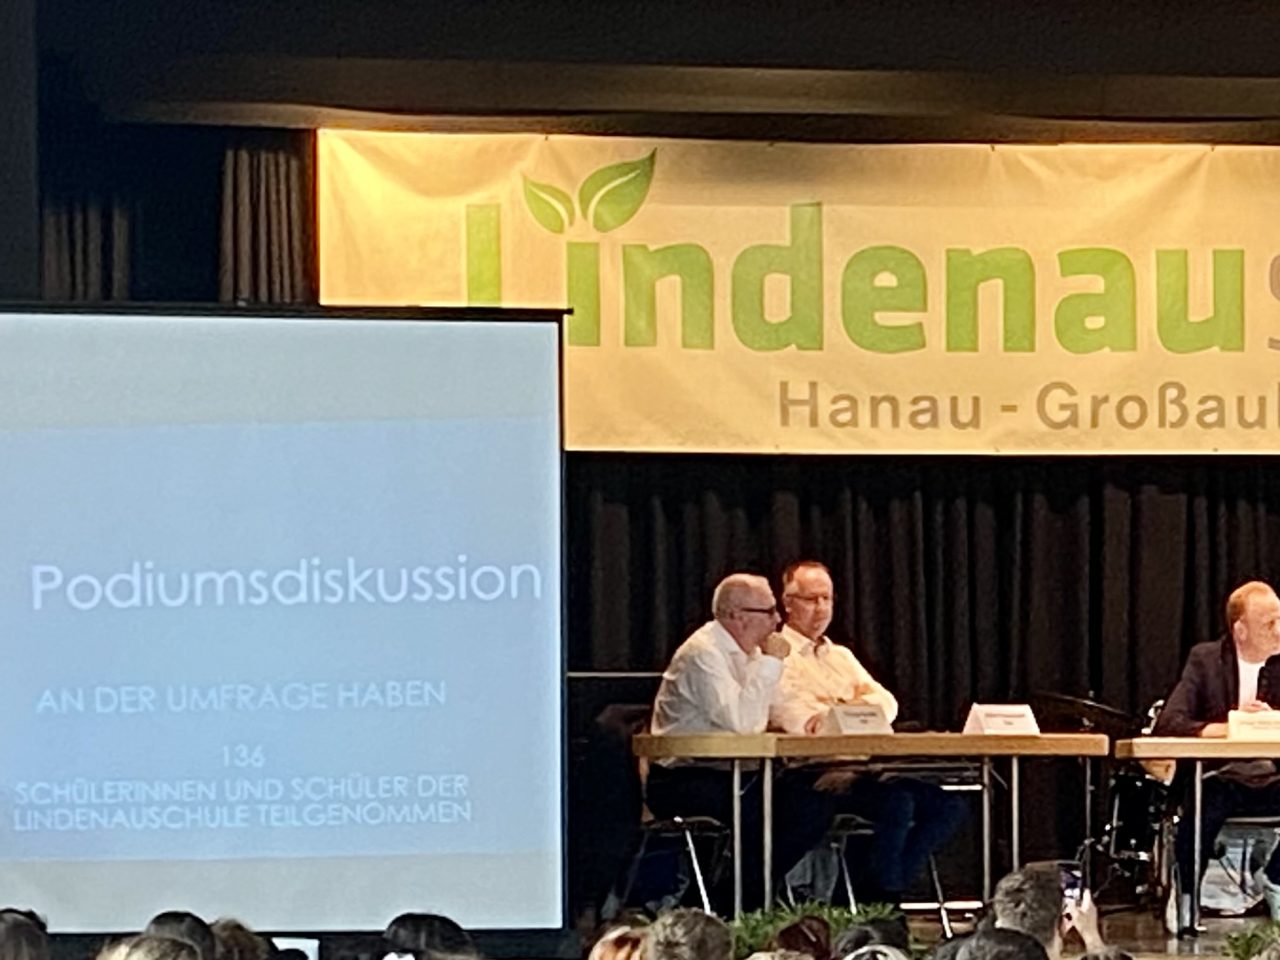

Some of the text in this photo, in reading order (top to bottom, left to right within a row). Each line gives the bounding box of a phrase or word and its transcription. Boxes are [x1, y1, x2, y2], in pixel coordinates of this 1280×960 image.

[31, 553, 543, 611] Podiumsdiskussion
[35, 679, 447, 714] AN DER UMFRAGE HABEN
[222, 743, 266, 768] 136
[14, 772, 469, 805] SCHÜLERINNEN UND SCHÜLER DER
[13, 800, 472, 831] LINDENAUSCHULE TEILGENOMMEN
